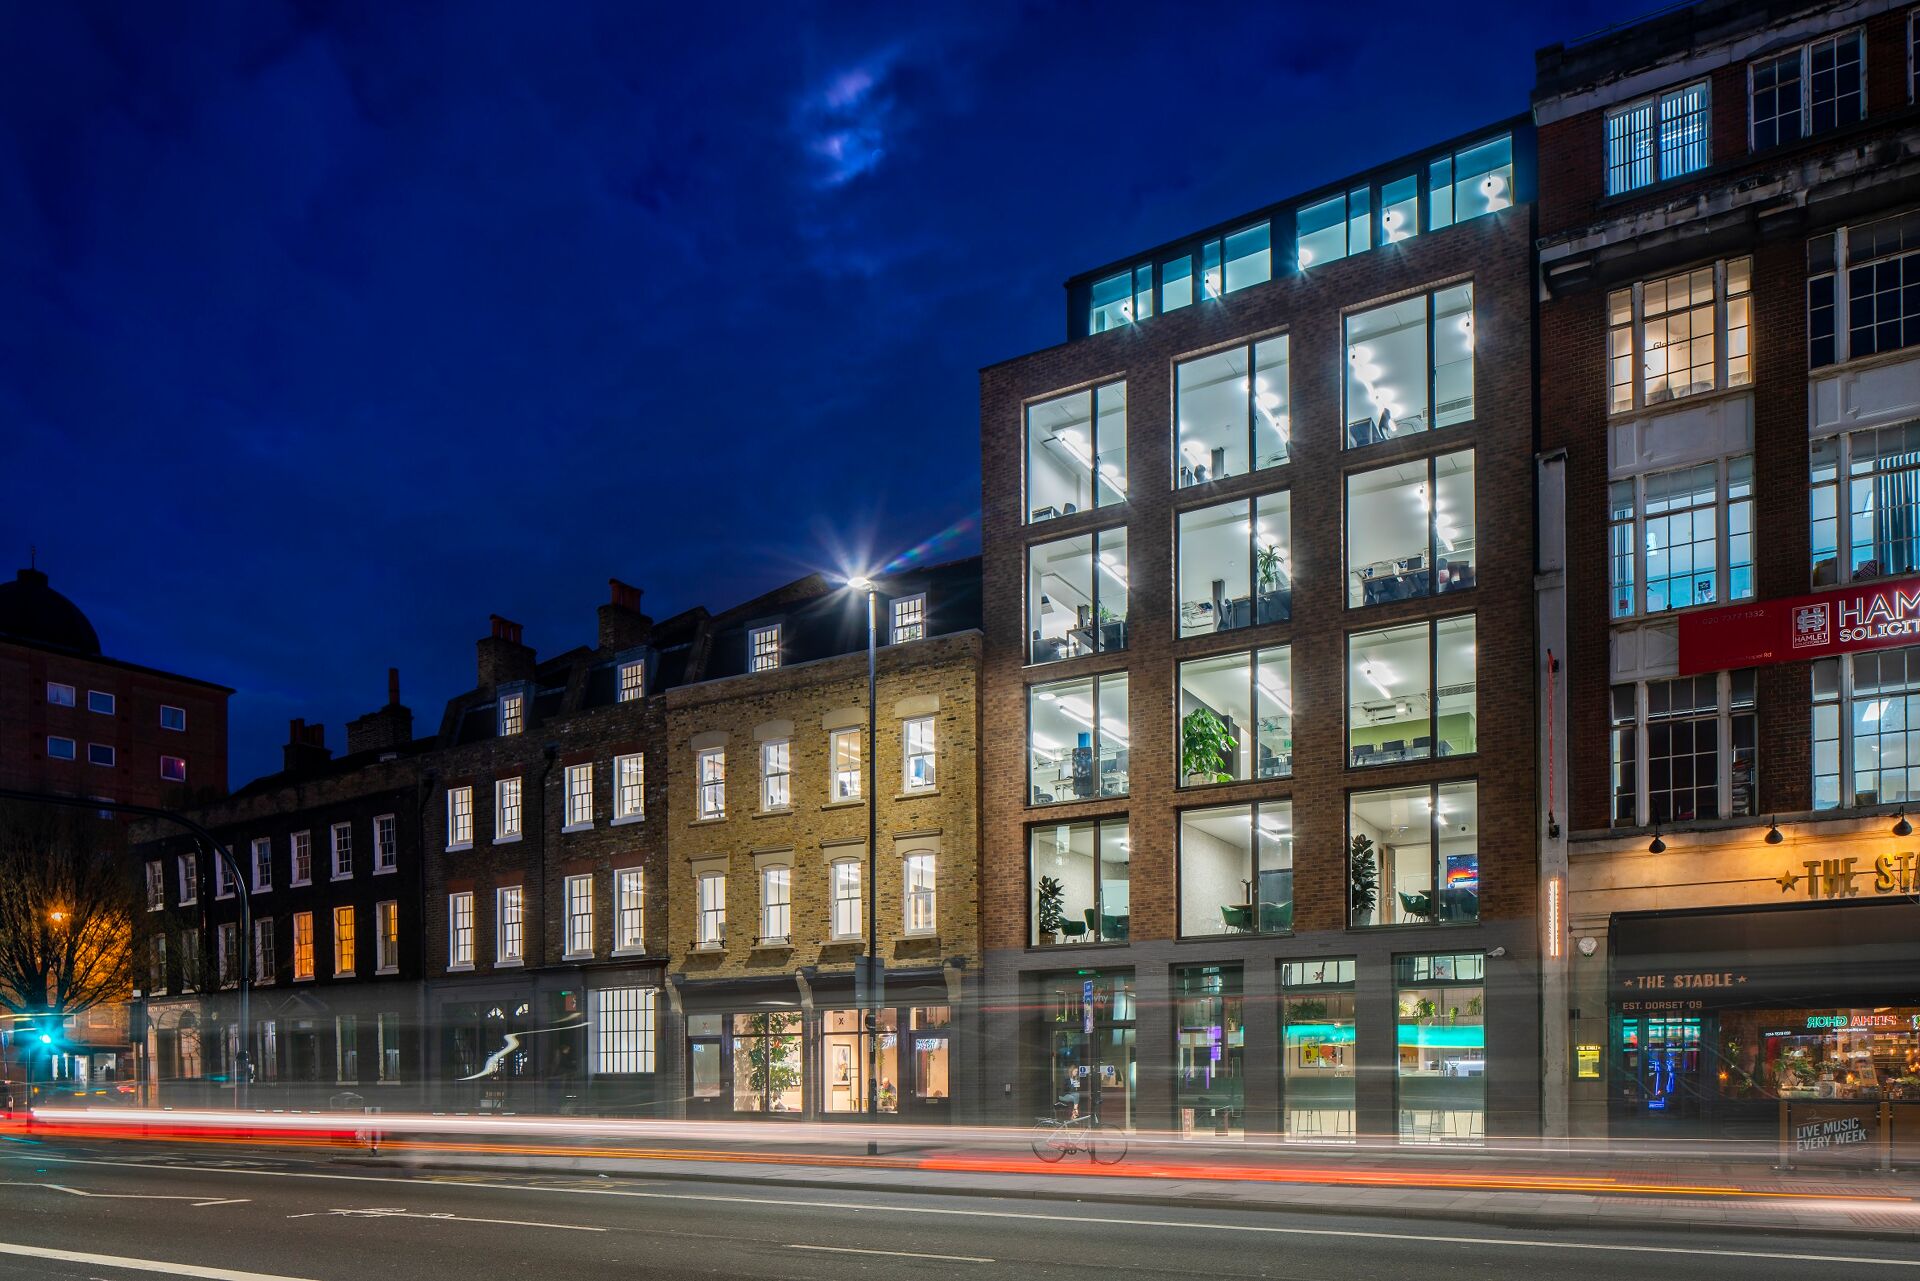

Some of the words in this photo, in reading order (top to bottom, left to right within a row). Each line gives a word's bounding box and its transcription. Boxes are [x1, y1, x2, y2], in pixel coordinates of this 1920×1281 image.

[1794, 632, 1827, 643] HAMLET
[1803, 857, 1859, 897] THE
[1637, 975, 1665, 989] THE
[1673, 973, 1733, 988] STABLE
[1623, 1002, 1642, 1010] EST.
[1645, 1001, 1684, 1009] DORSET
[1796, 1123, 1820, 1139] LIVE
[1823, 1116, 1860, 1135] MUSIC
[1796, 1134, 1831, 1152] EVERY
[1834, 1128, 1866, 1145] WEEK
